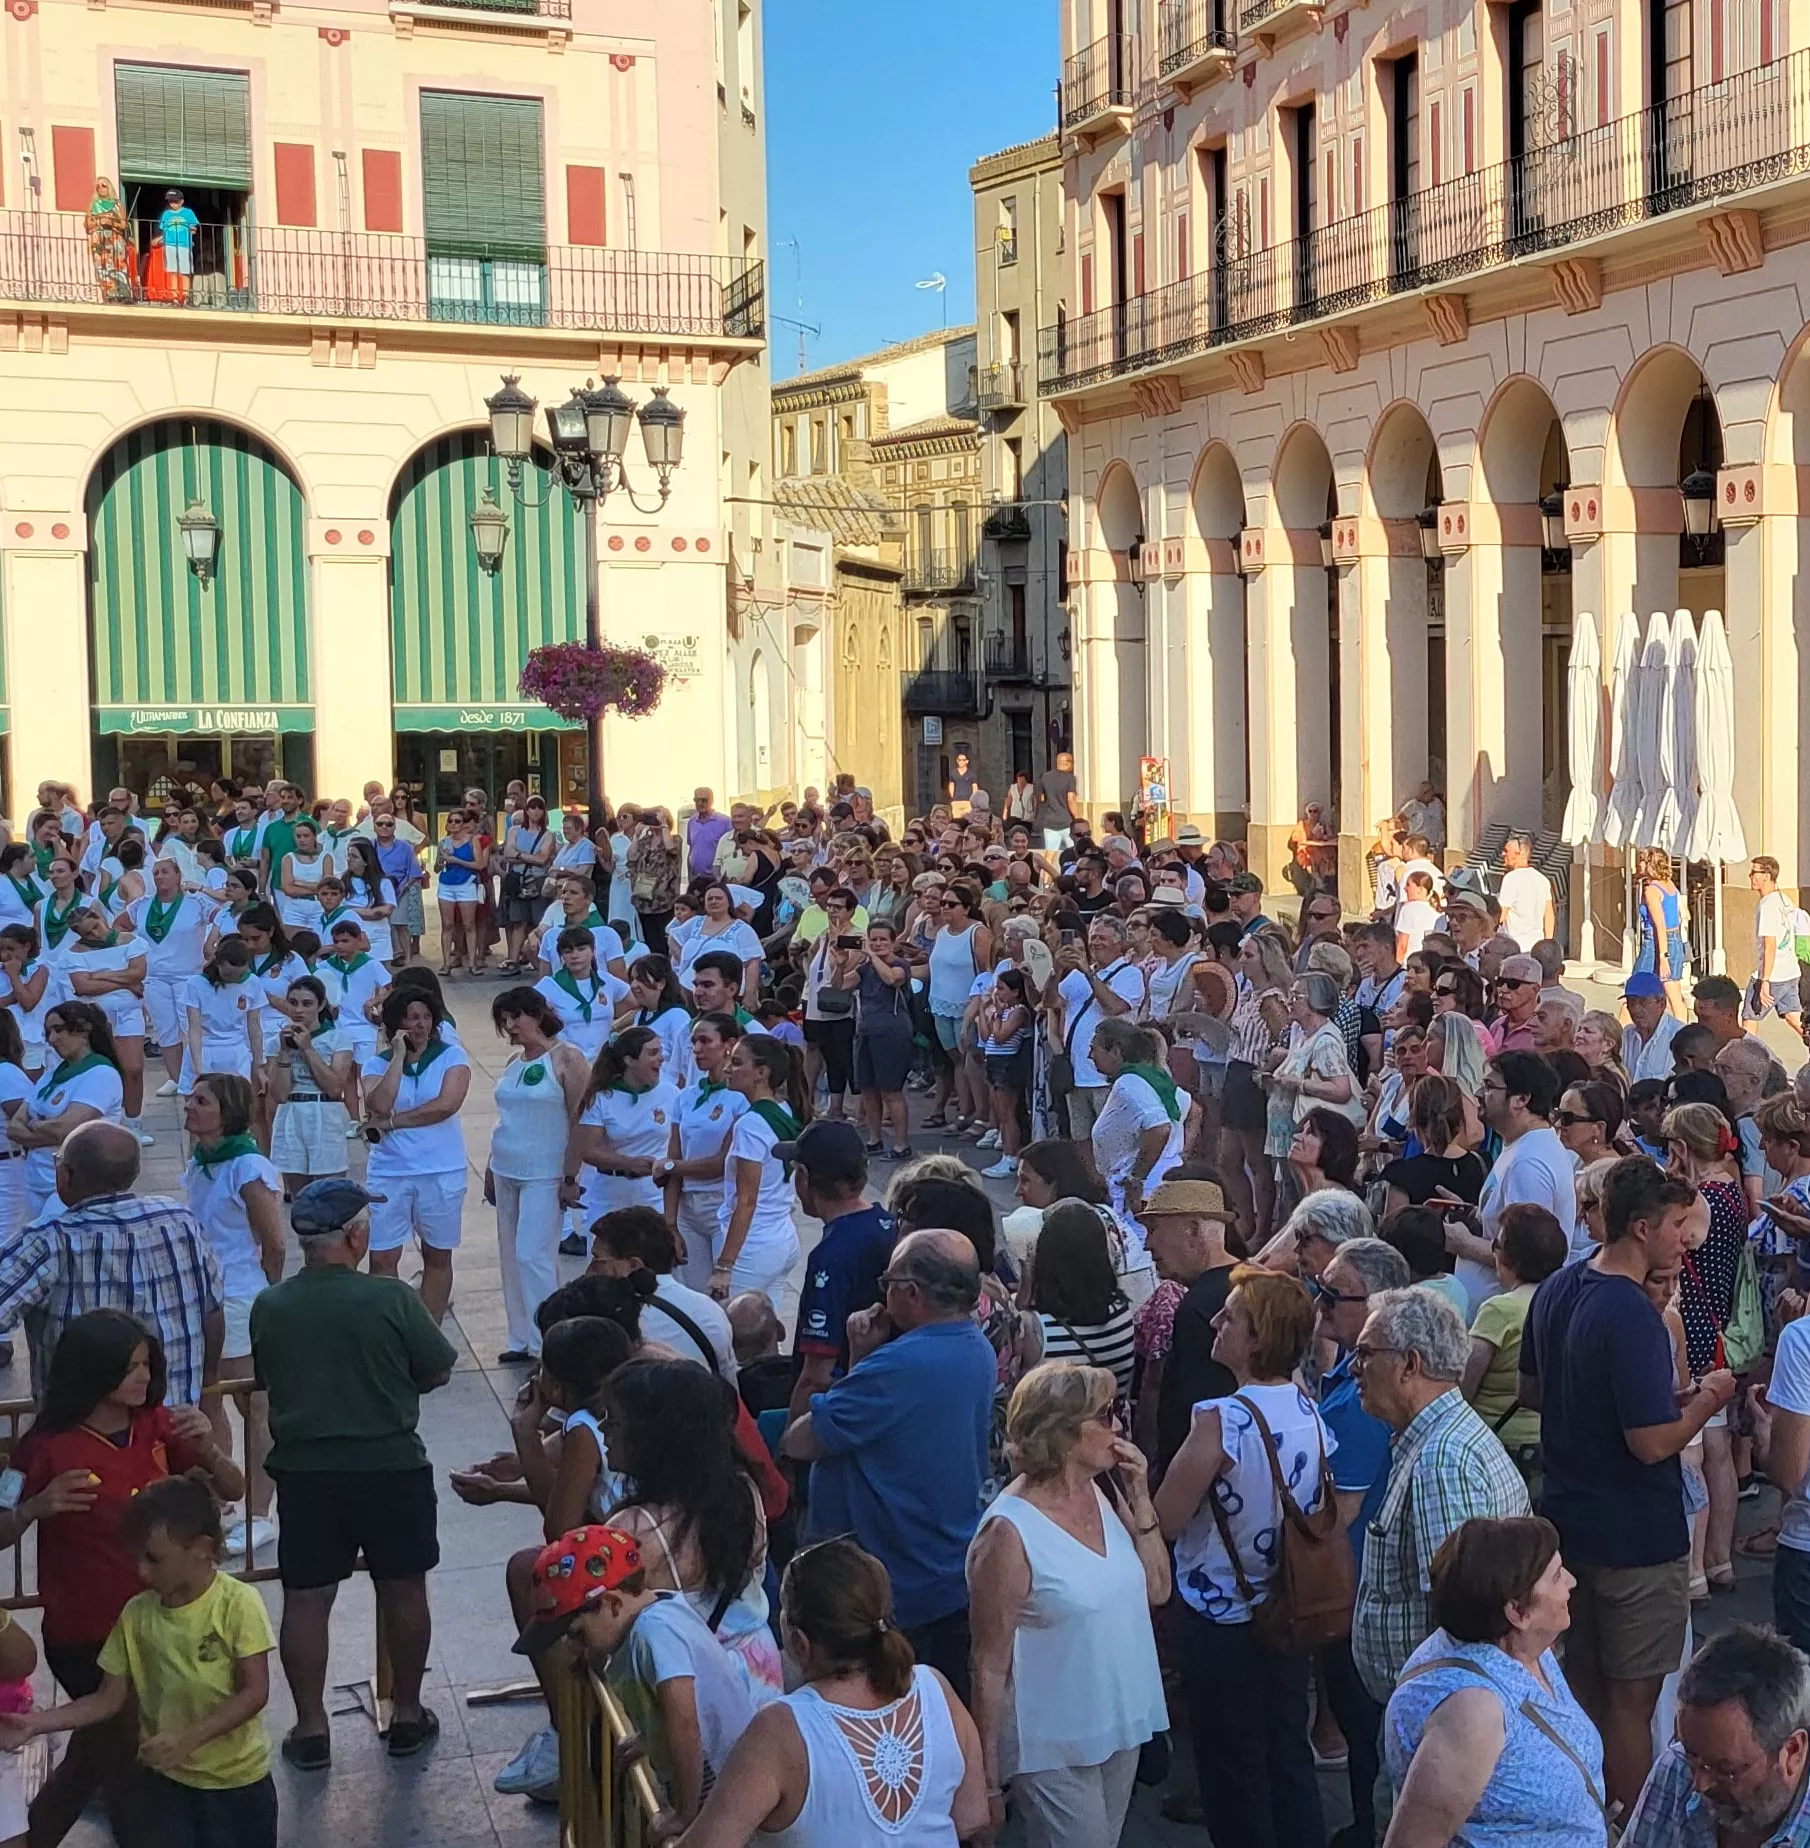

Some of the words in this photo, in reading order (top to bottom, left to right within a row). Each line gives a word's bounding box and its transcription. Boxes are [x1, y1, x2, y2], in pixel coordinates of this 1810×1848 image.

[199, 710, 213, 728] LA
[216, 710, 279, 728] CONFIANZA
[460, 709, 494, 724] desde
[500, 712, 525, 726] 1871
